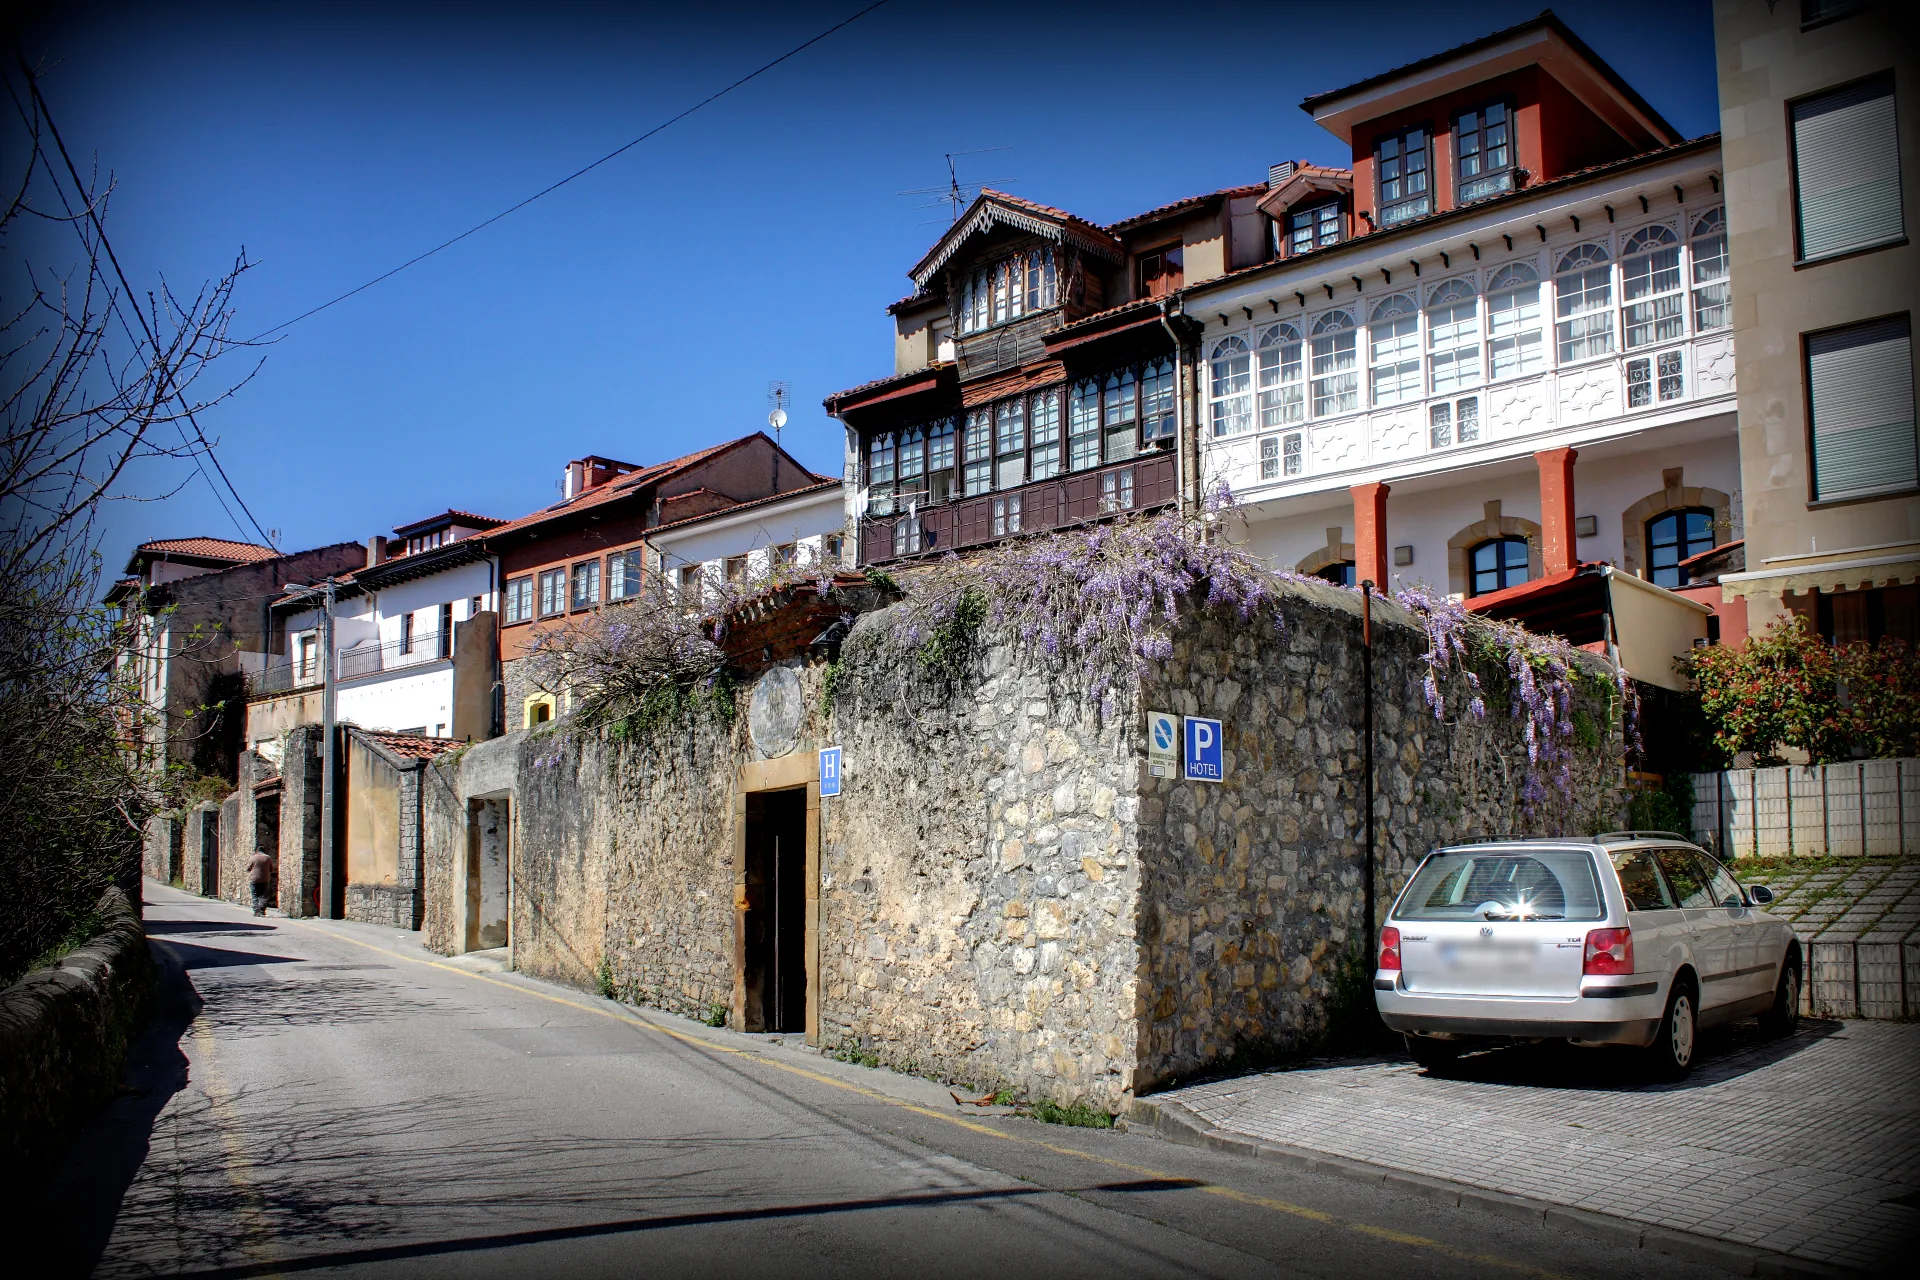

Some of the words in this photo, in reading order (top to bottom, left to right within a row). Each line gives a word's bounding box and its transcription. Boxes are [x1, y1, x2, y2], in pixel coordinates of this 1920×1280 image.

[1194, 722, 1213, 761] P
[823, 753, 836, 779] H
[1190, 762, 1219, 776] HOTEL
